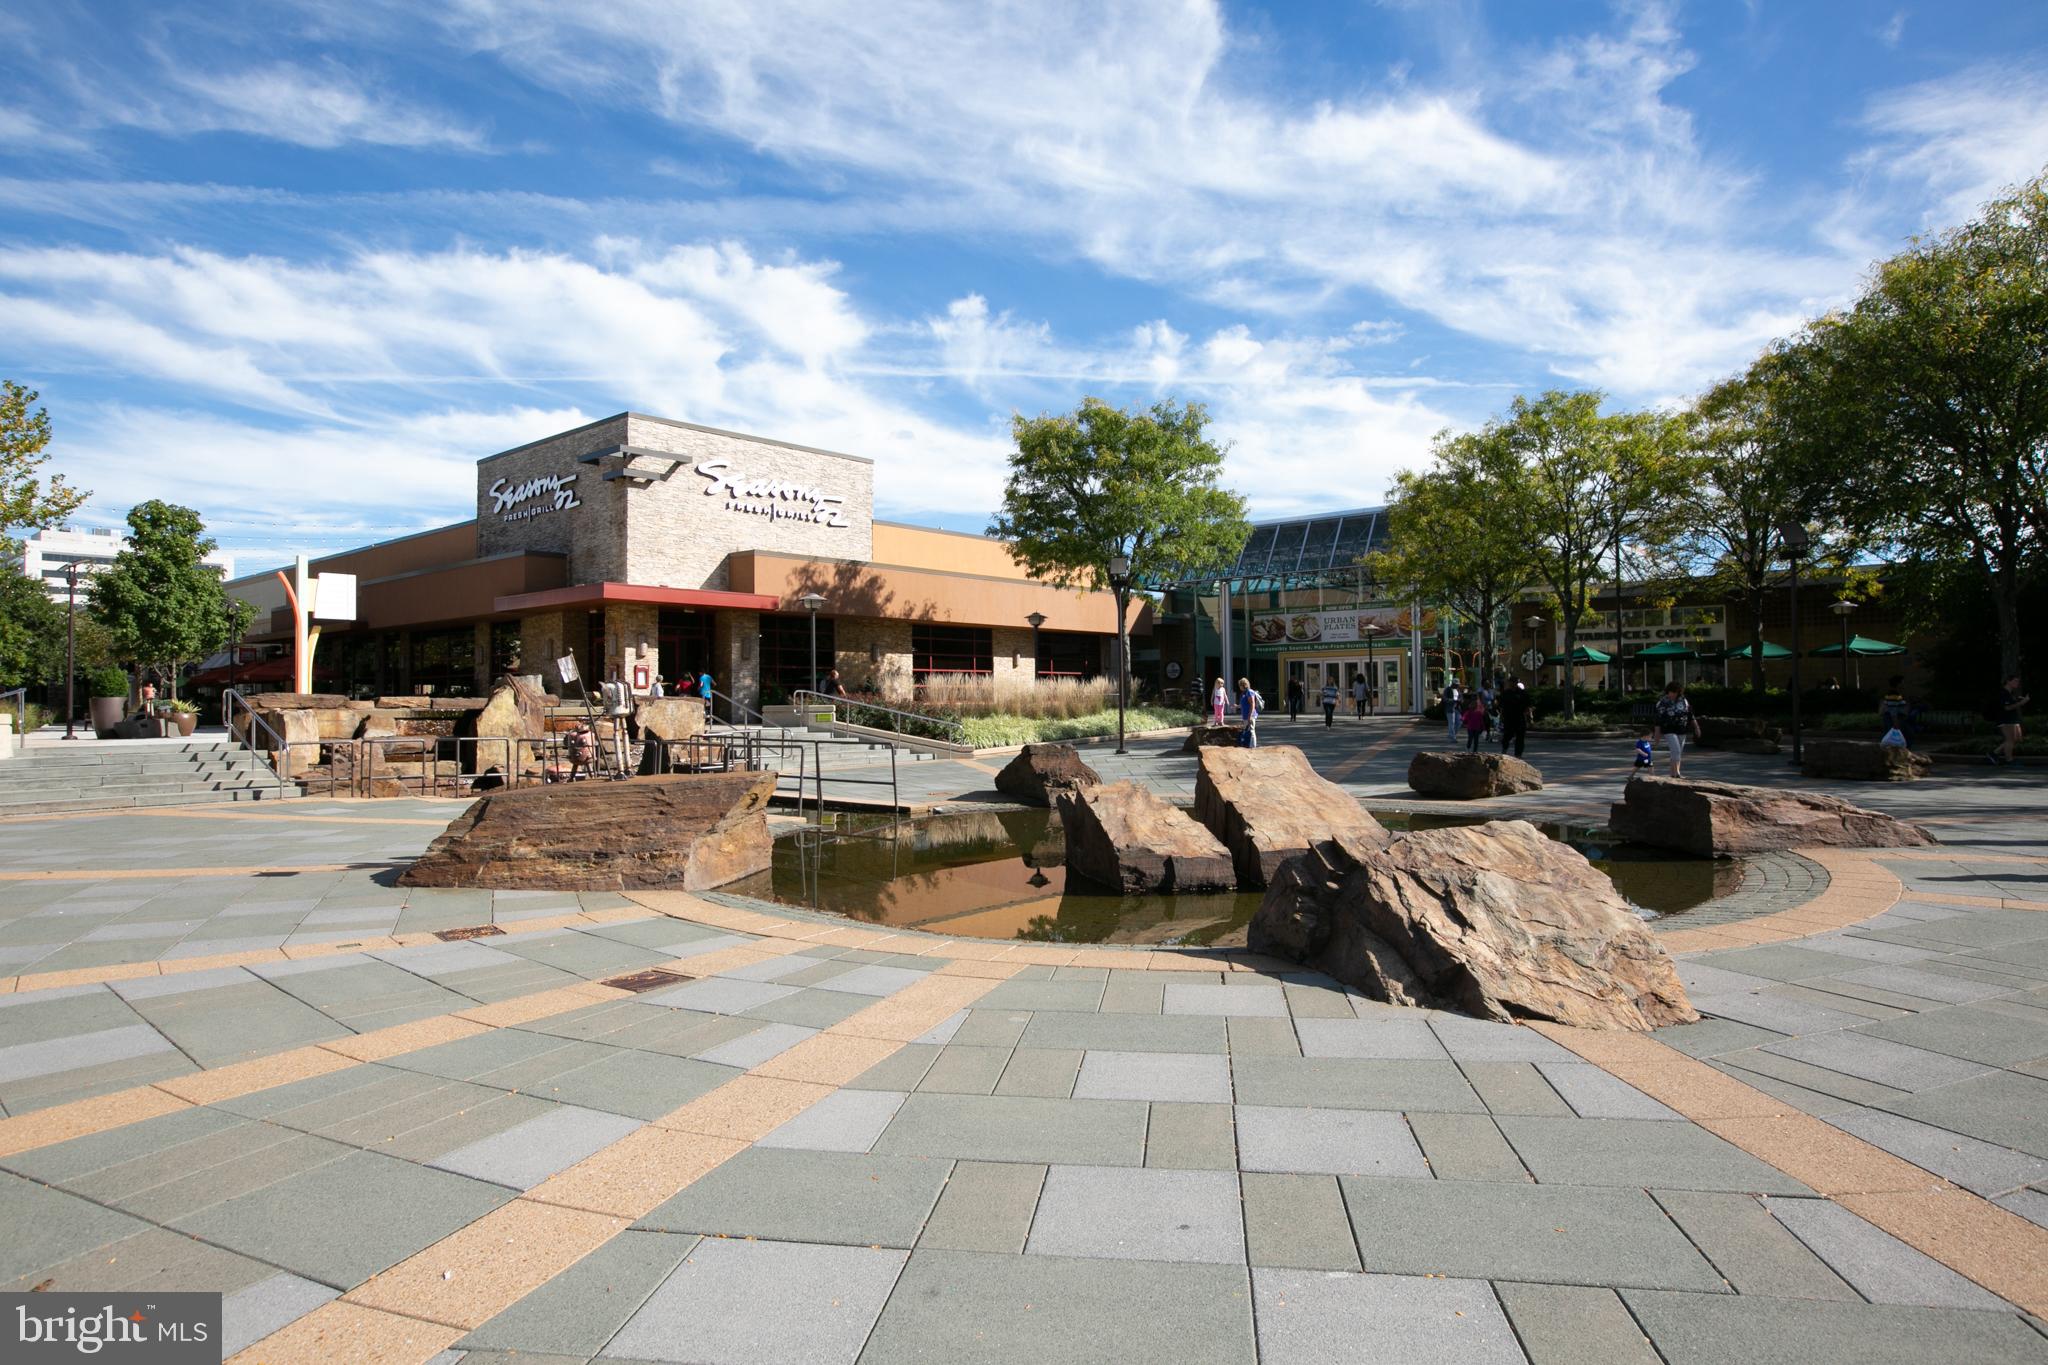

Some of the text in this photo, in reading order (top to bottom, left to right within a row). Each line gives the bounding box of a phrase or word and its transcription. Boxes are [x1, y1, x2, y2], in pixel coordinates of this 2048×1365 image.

[694, 459, 843, 503] Seasons
[489, 474, 580, 514] Seasons 52
[1323, 615, 1357, 625] URBAN
[1323, 622, 1357, 631] PLATES
[1575, 629, 1651, 641] TARBCKS
